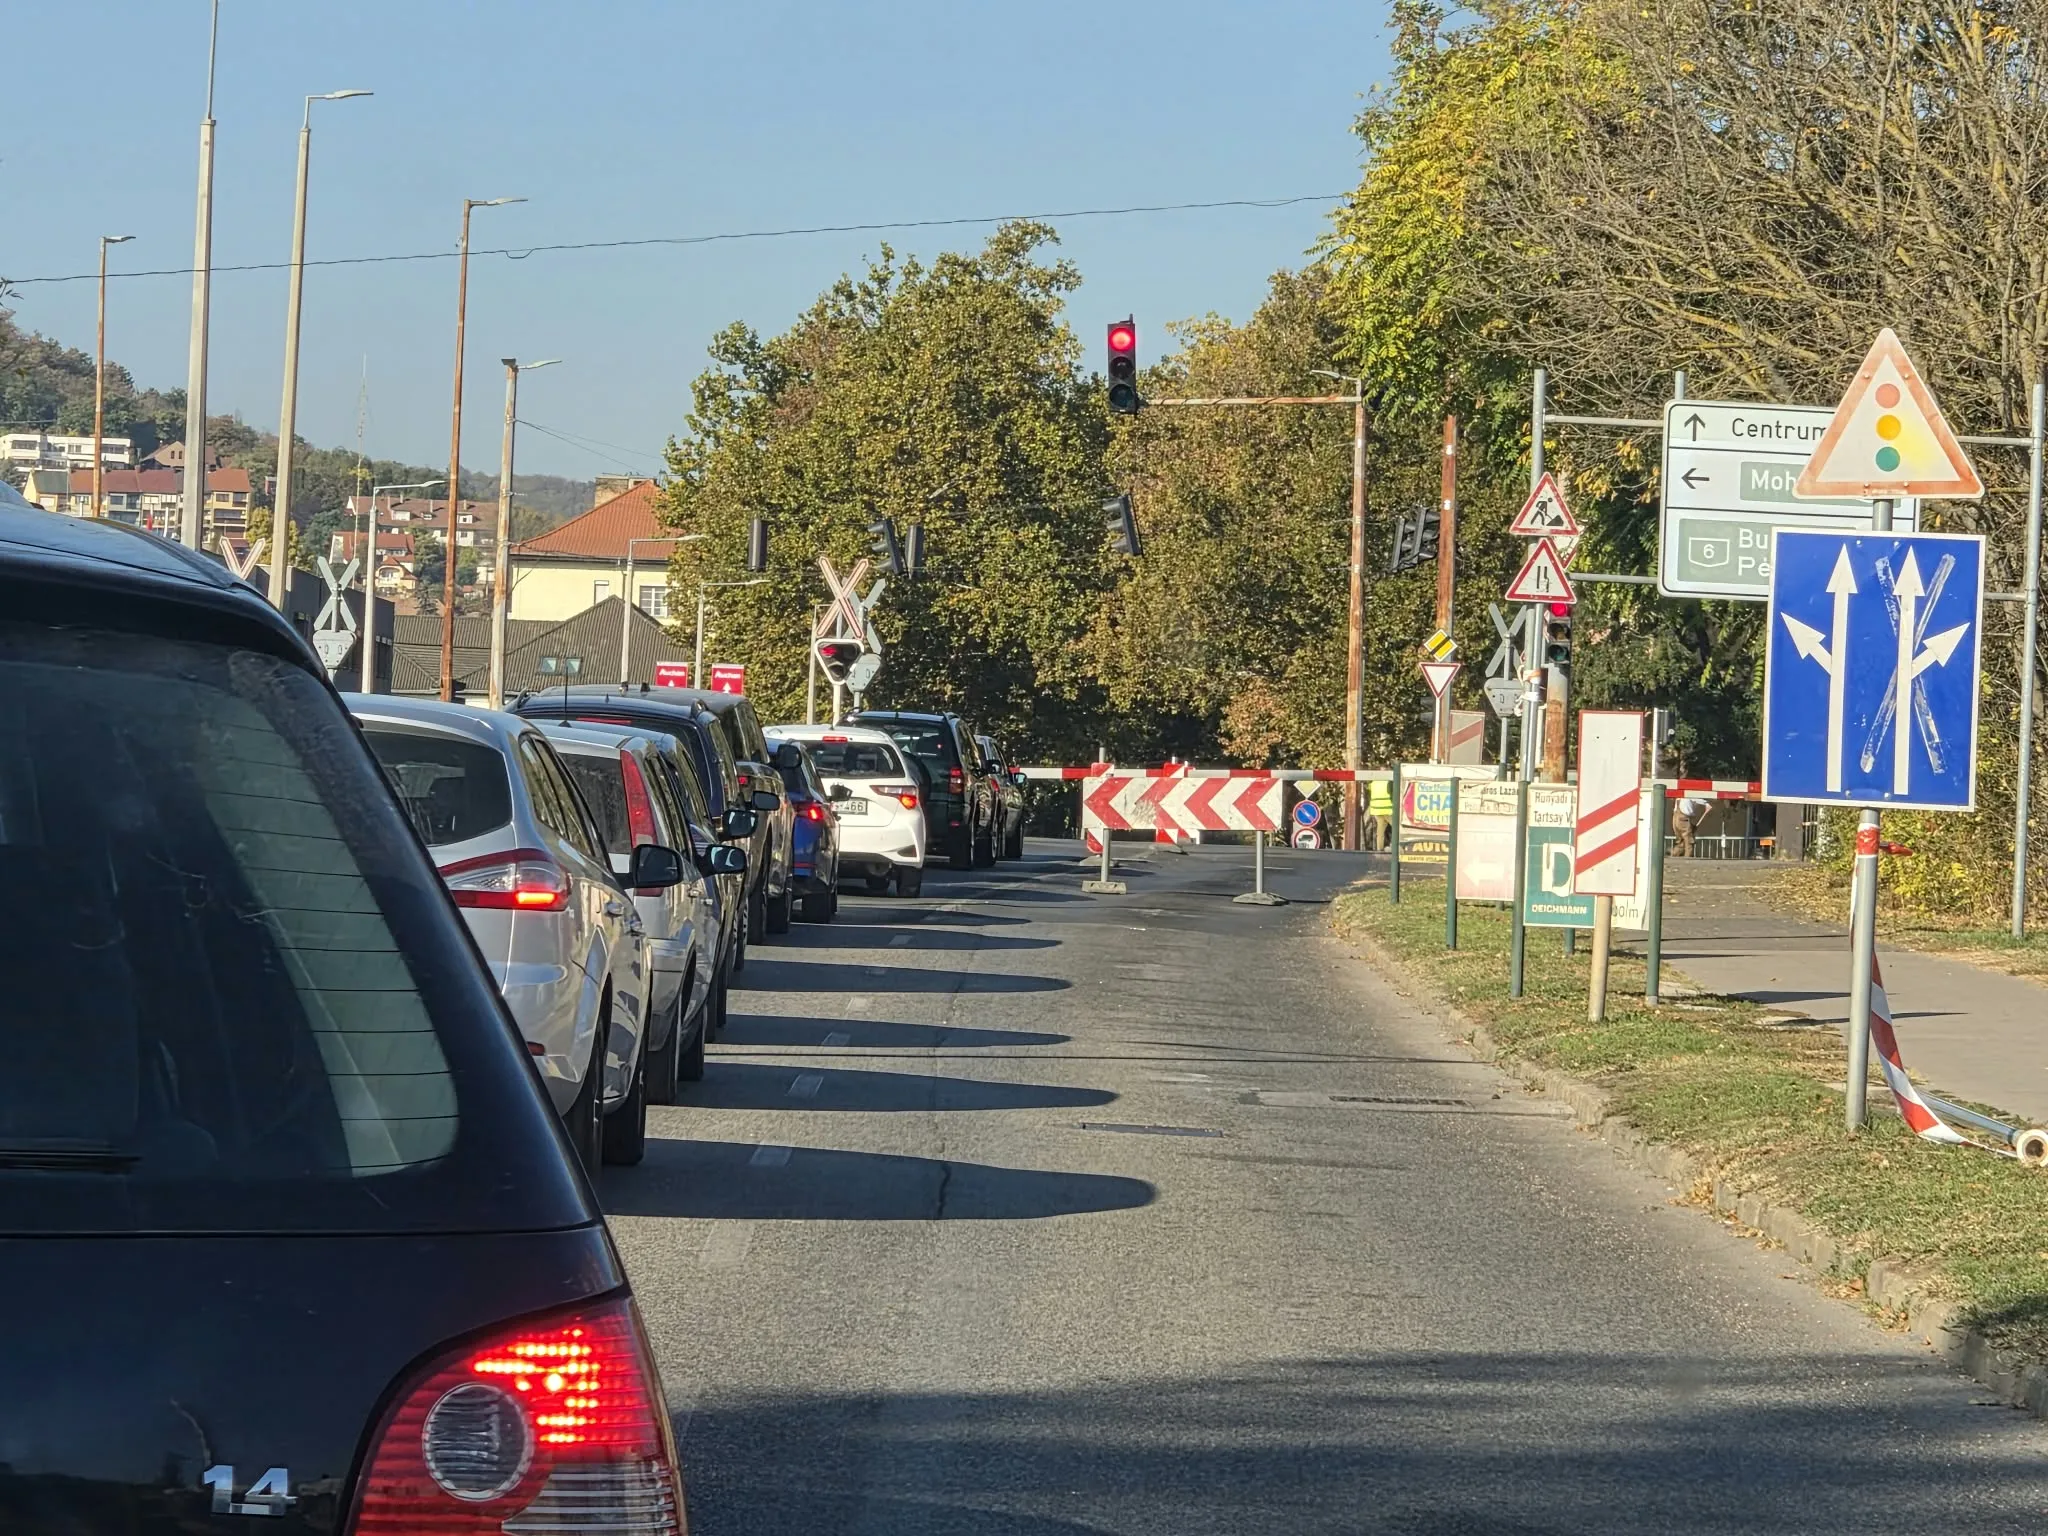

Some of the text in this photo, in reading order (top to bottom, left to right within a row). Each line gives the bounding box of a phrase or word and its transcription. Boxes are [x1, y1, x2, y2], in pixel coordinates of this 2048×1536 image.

[1738, 527, 1769, 549] Bu
[1703, 543, 1715, 559] 6
[1531, 904, 1588, 914] DEICHMANN
